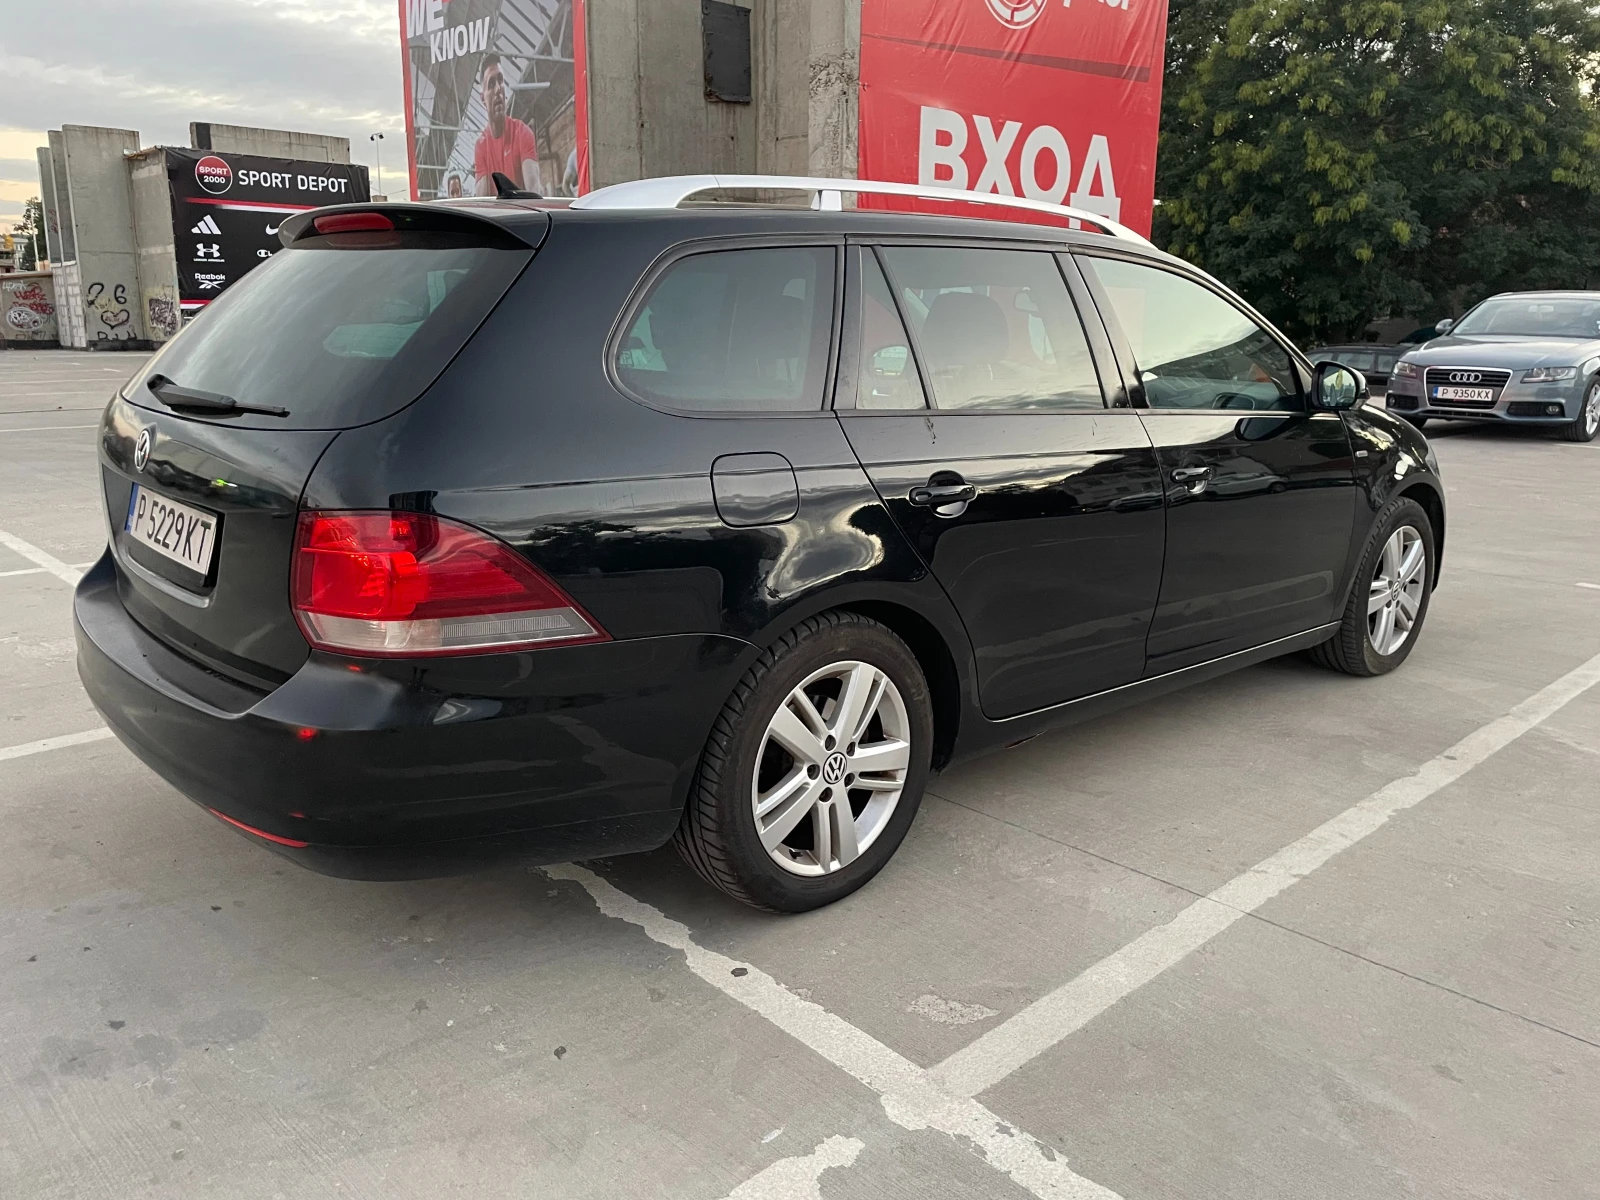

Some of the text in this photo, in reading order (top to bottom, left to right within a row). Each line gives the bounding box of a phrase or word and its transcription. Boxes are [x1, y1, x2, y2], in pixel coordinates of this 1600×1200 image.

[406, 0, 444, 39] WE
[430, 16, 490, 65] KNOW
[198, 165, 228, 176] SPORT
[203, 175, 226, 184] 2000
[918, 105, 1121, 230] ВХОД
[238, 169, 348, 194] SPORT DEPOT
[194, 272, 226, 281] Reebok
[1441, 388, 1449, 397] P
[134, 494, 147, 532] P
